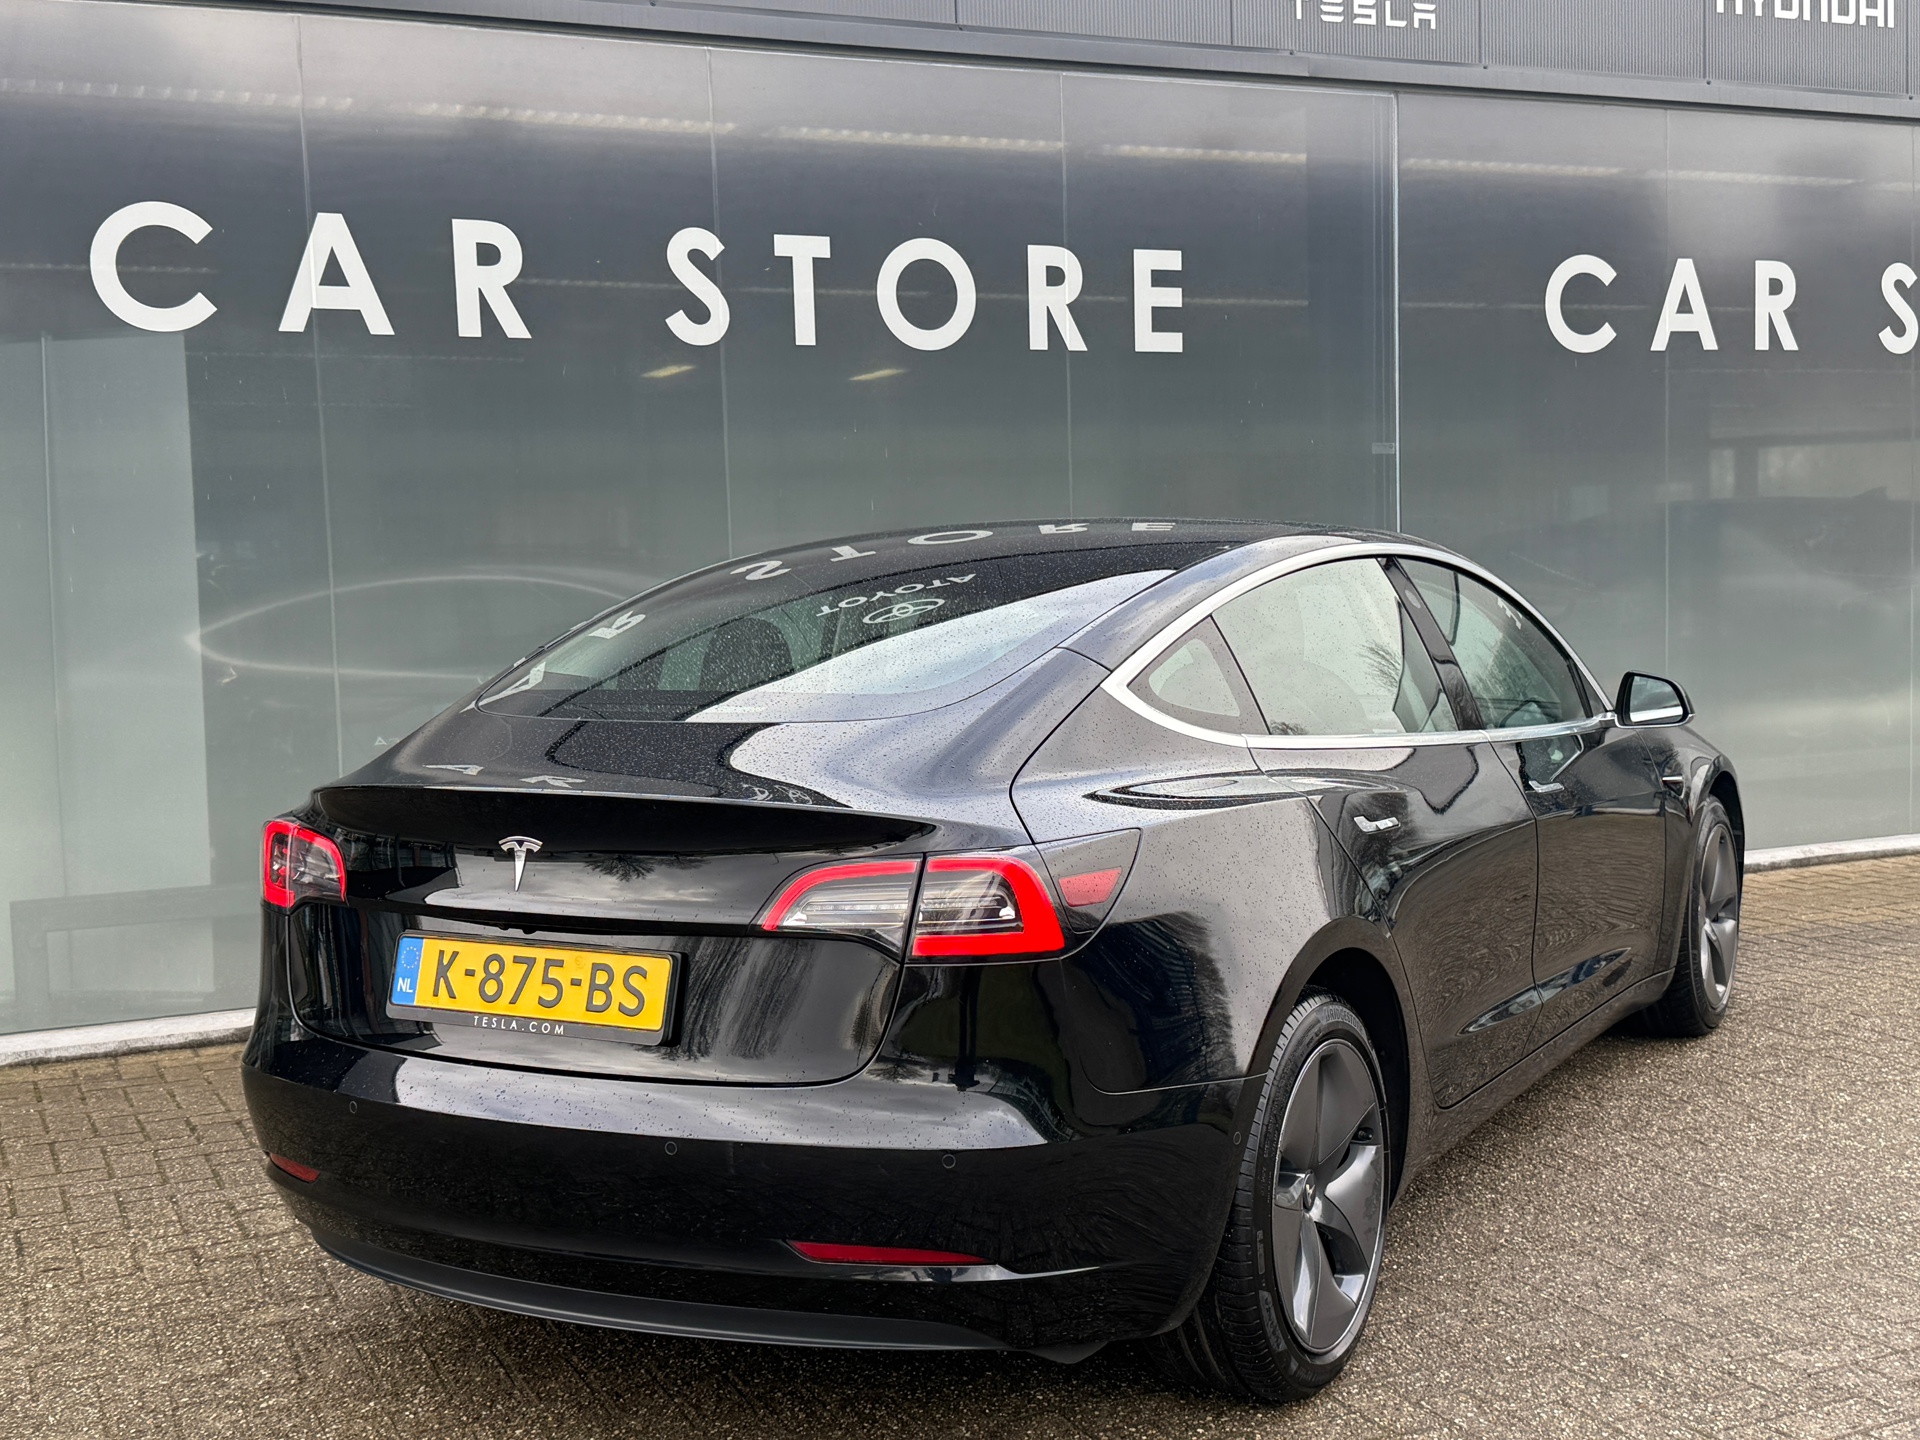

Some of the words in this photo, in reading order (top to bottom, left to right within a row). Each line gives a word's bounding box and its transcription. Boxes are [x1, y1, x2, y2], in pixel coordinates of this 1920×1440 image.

[1295, 0, 1437, 30] TESLA
[89, 201, 532, 336] CAR
[665, 227, 1184, 353] STORE
[1545, 254, 1799, 353] CAR
[397, 976, 413, 993] NL
[432, 949, 648, 1017] K-875-BS
[473, 1015, 564, 1035] TESLA.COM
